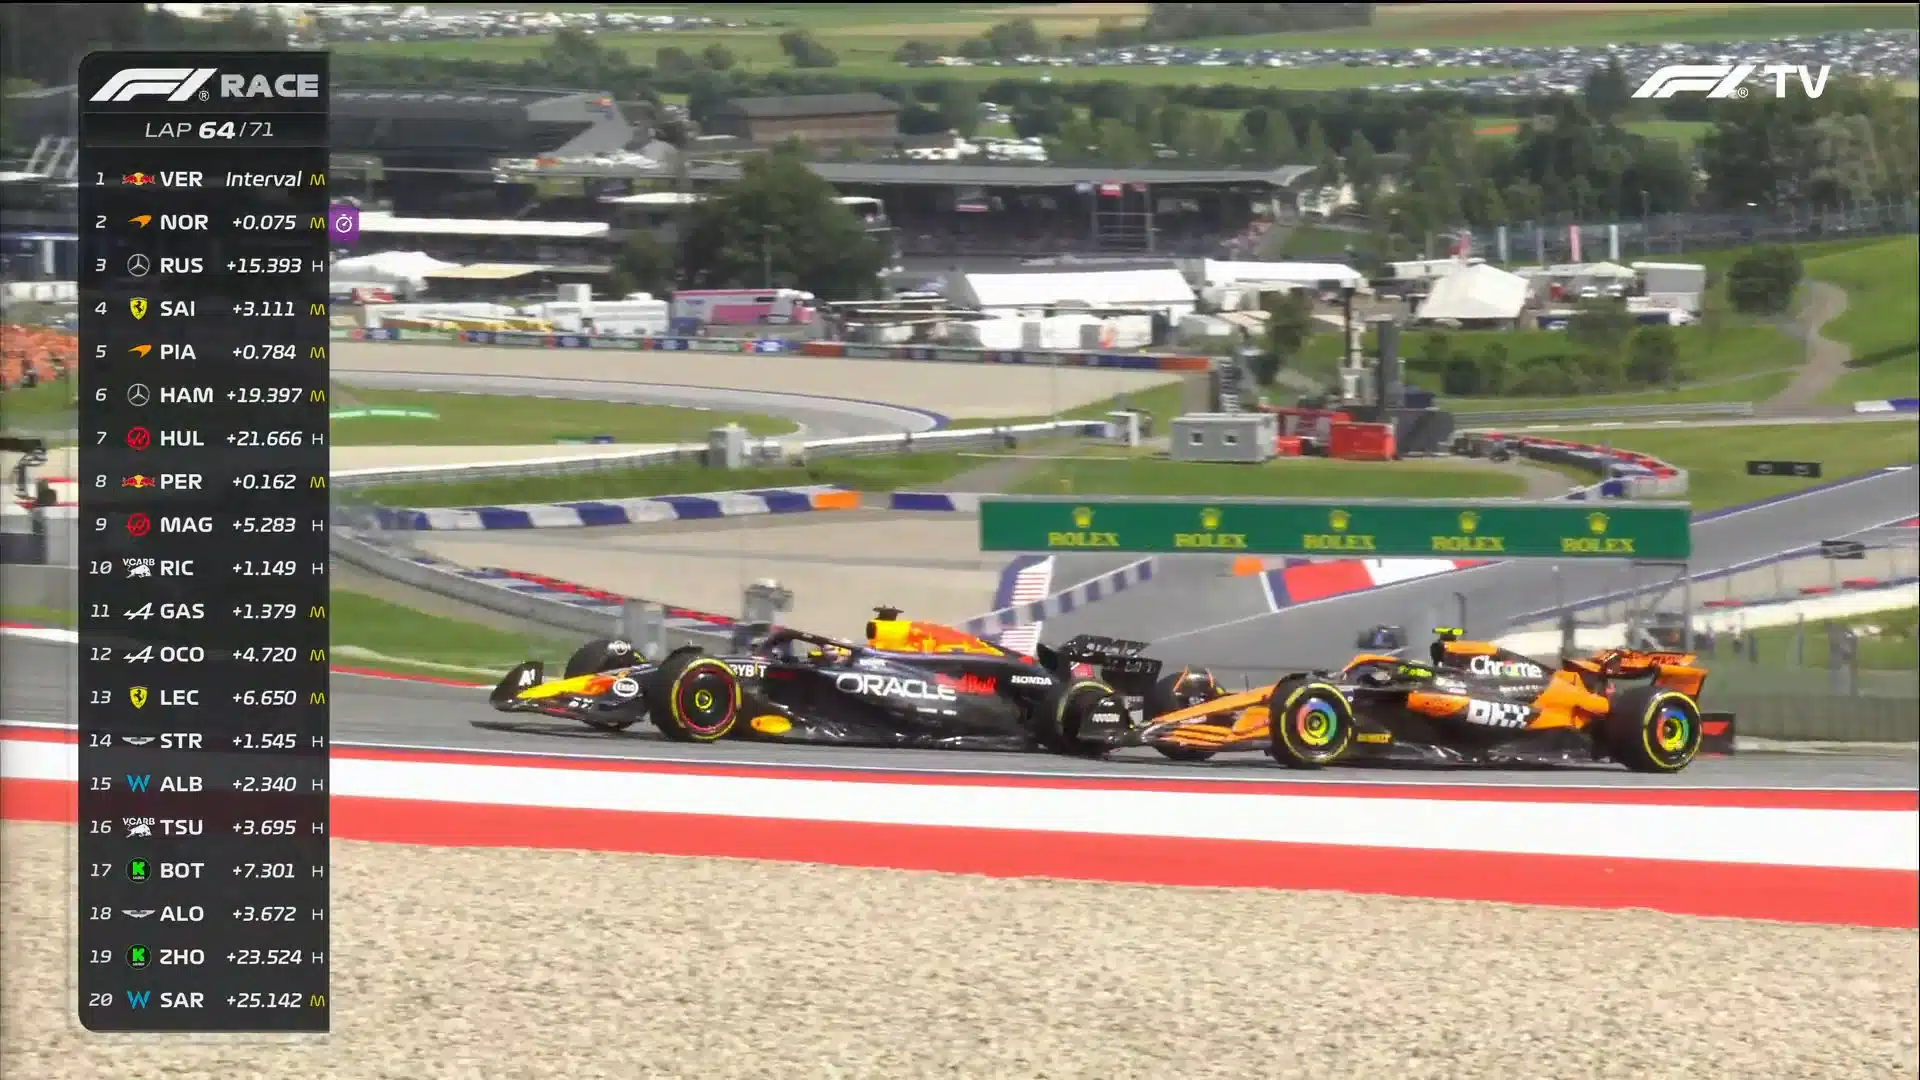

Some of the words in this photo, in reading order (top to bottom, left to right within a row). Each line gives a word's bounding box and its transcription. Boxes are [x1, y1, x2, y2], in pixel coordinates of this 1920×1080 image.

[1048, 532, 1120, 547] ROLEX
[1174, 533, 1247, 548] ROLEX
[1303, 534, 1377, 550] ROLEX
[1431, 536, 1504, 551] ROLEX
[1561, 538, 1635, 553] ROLEX
[1469, 655, 1543, 679] Chrome
[836, 672, 957, 701] ORACLE
[1011, 675, 1053, 686] HONDA
